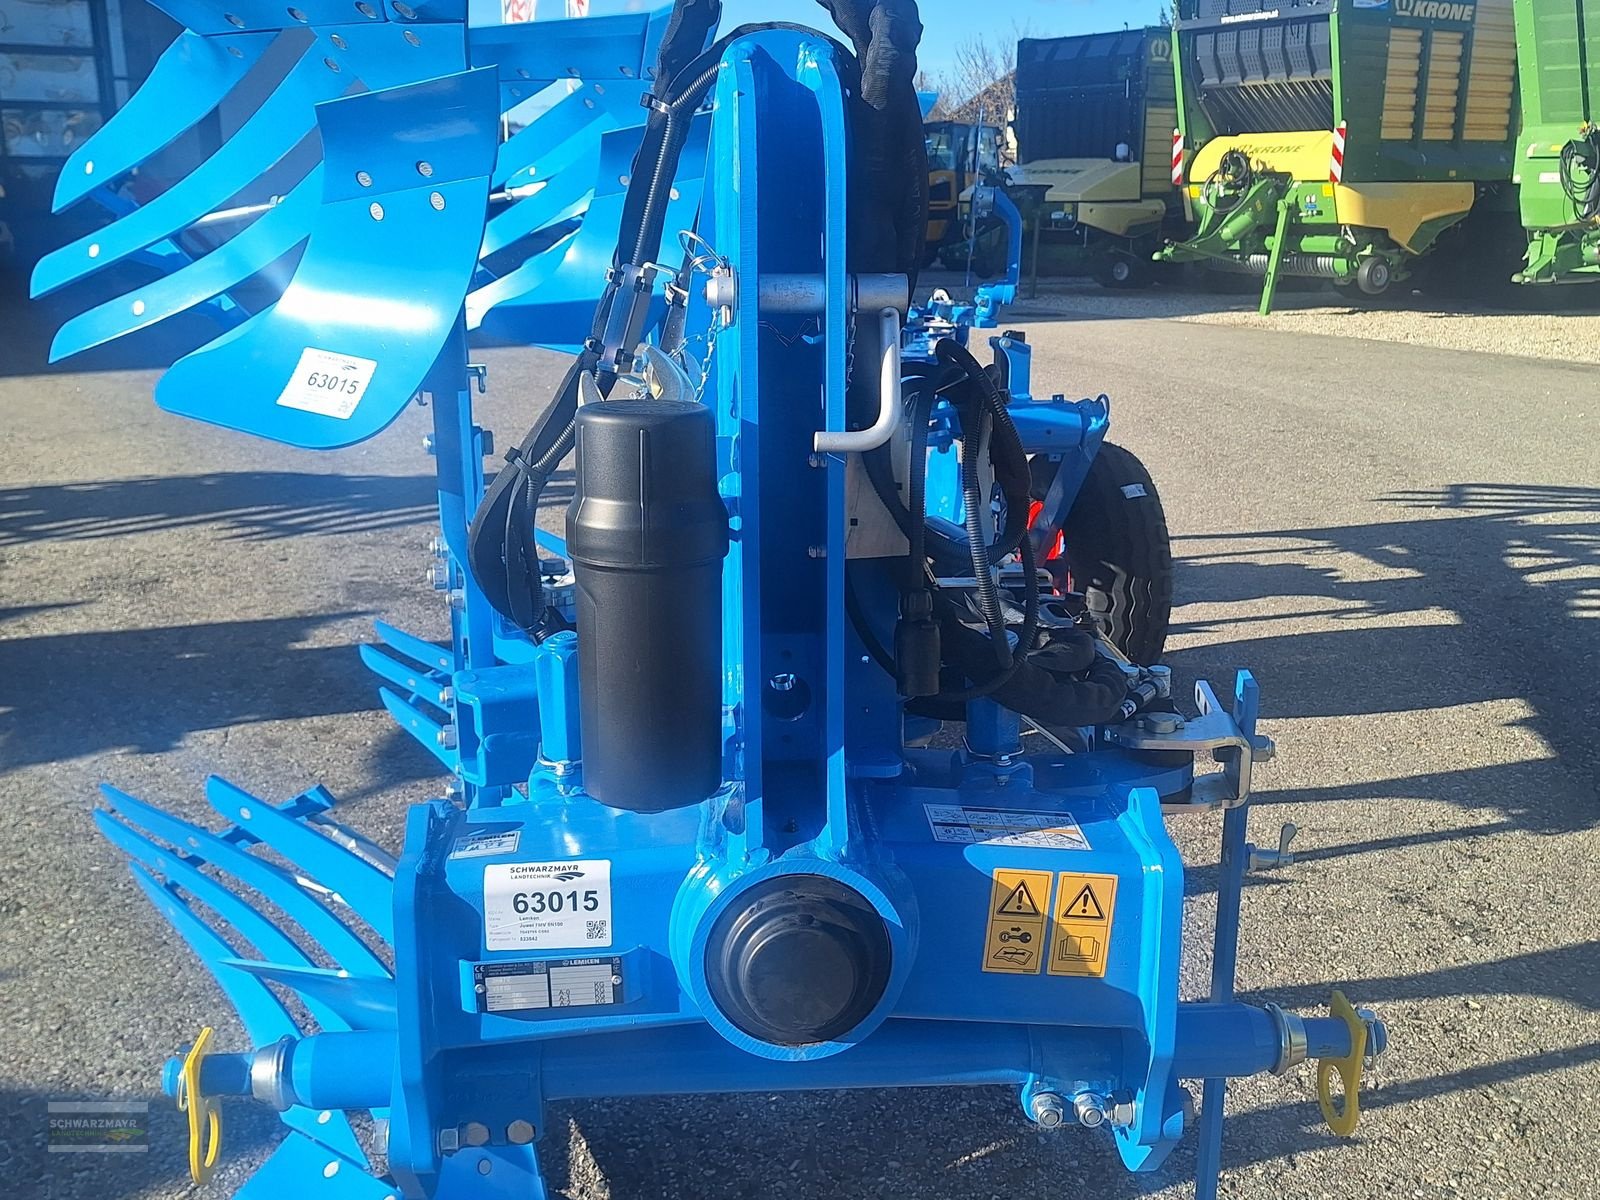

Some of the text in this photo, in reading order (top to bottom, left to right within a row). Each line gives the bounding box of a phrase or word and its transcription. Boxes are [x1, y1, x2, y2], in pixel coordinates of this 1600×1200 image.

[1413, 1, 1475, 21] KRONE
[307, 372, 360, 395] 63015
[510, 865, 579, 874] SCHWARZMAYR
[512, 890, 599, 914] 63015
[569, 958, 600, 966] LEMKEN
